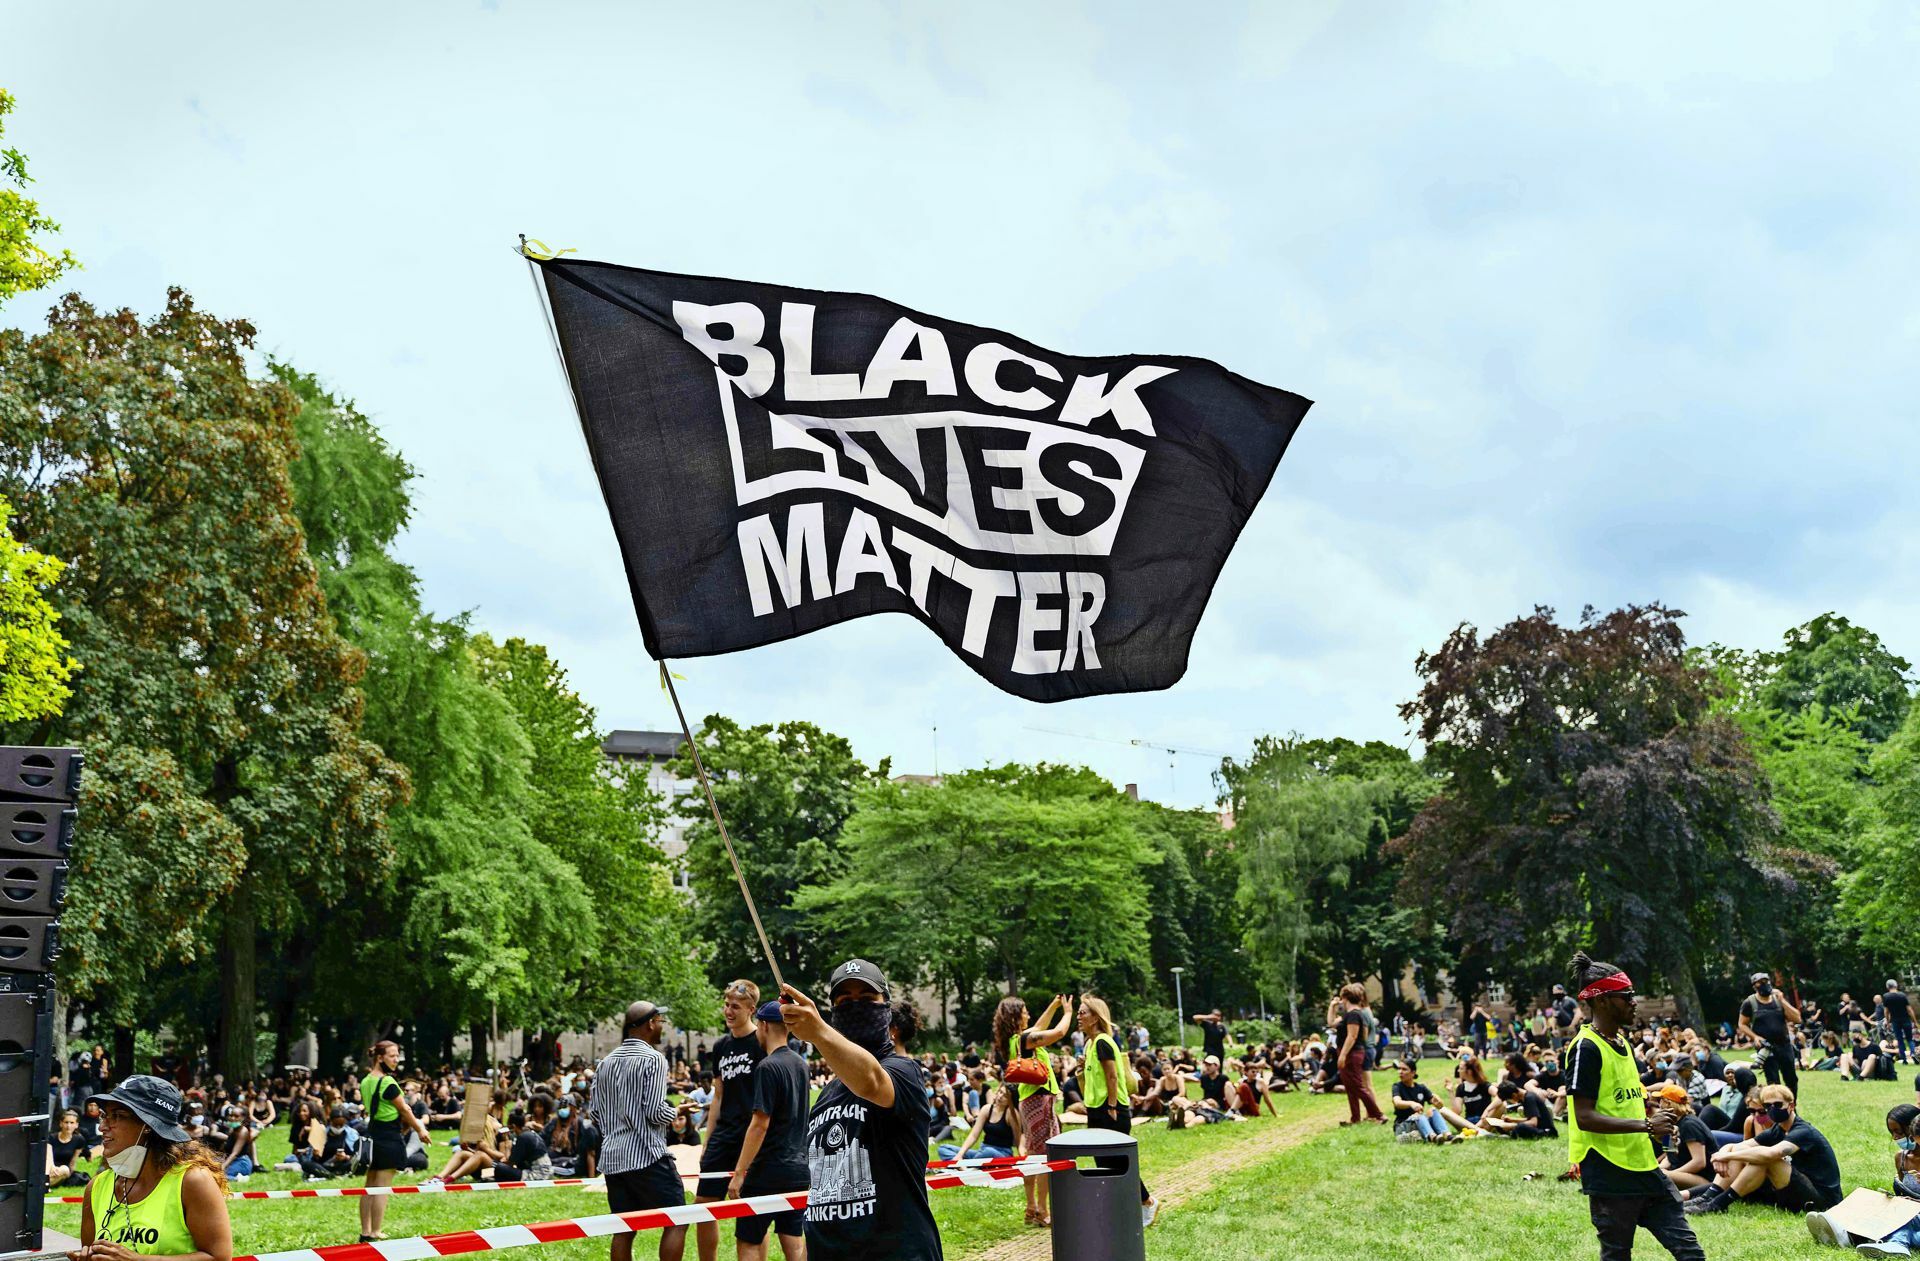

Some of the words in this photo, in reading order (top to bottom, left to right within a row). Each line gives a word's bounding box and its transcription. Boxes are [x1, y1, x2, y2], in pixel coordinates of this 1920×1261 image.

[672, 299, 1180, 437] BLACK
[728, 378, 1122, 537] LIVES
[736, 501, 1106, 675] MATTER
[845, 961, 861, 974] LA
[154, 1097, 175, 1112] KANI
[806, 1103, 868, 1137] EINTRACHT
[803, 1198, 877, 1222] ANKFURT
[115, 1226, 159, 1245] JAKO
